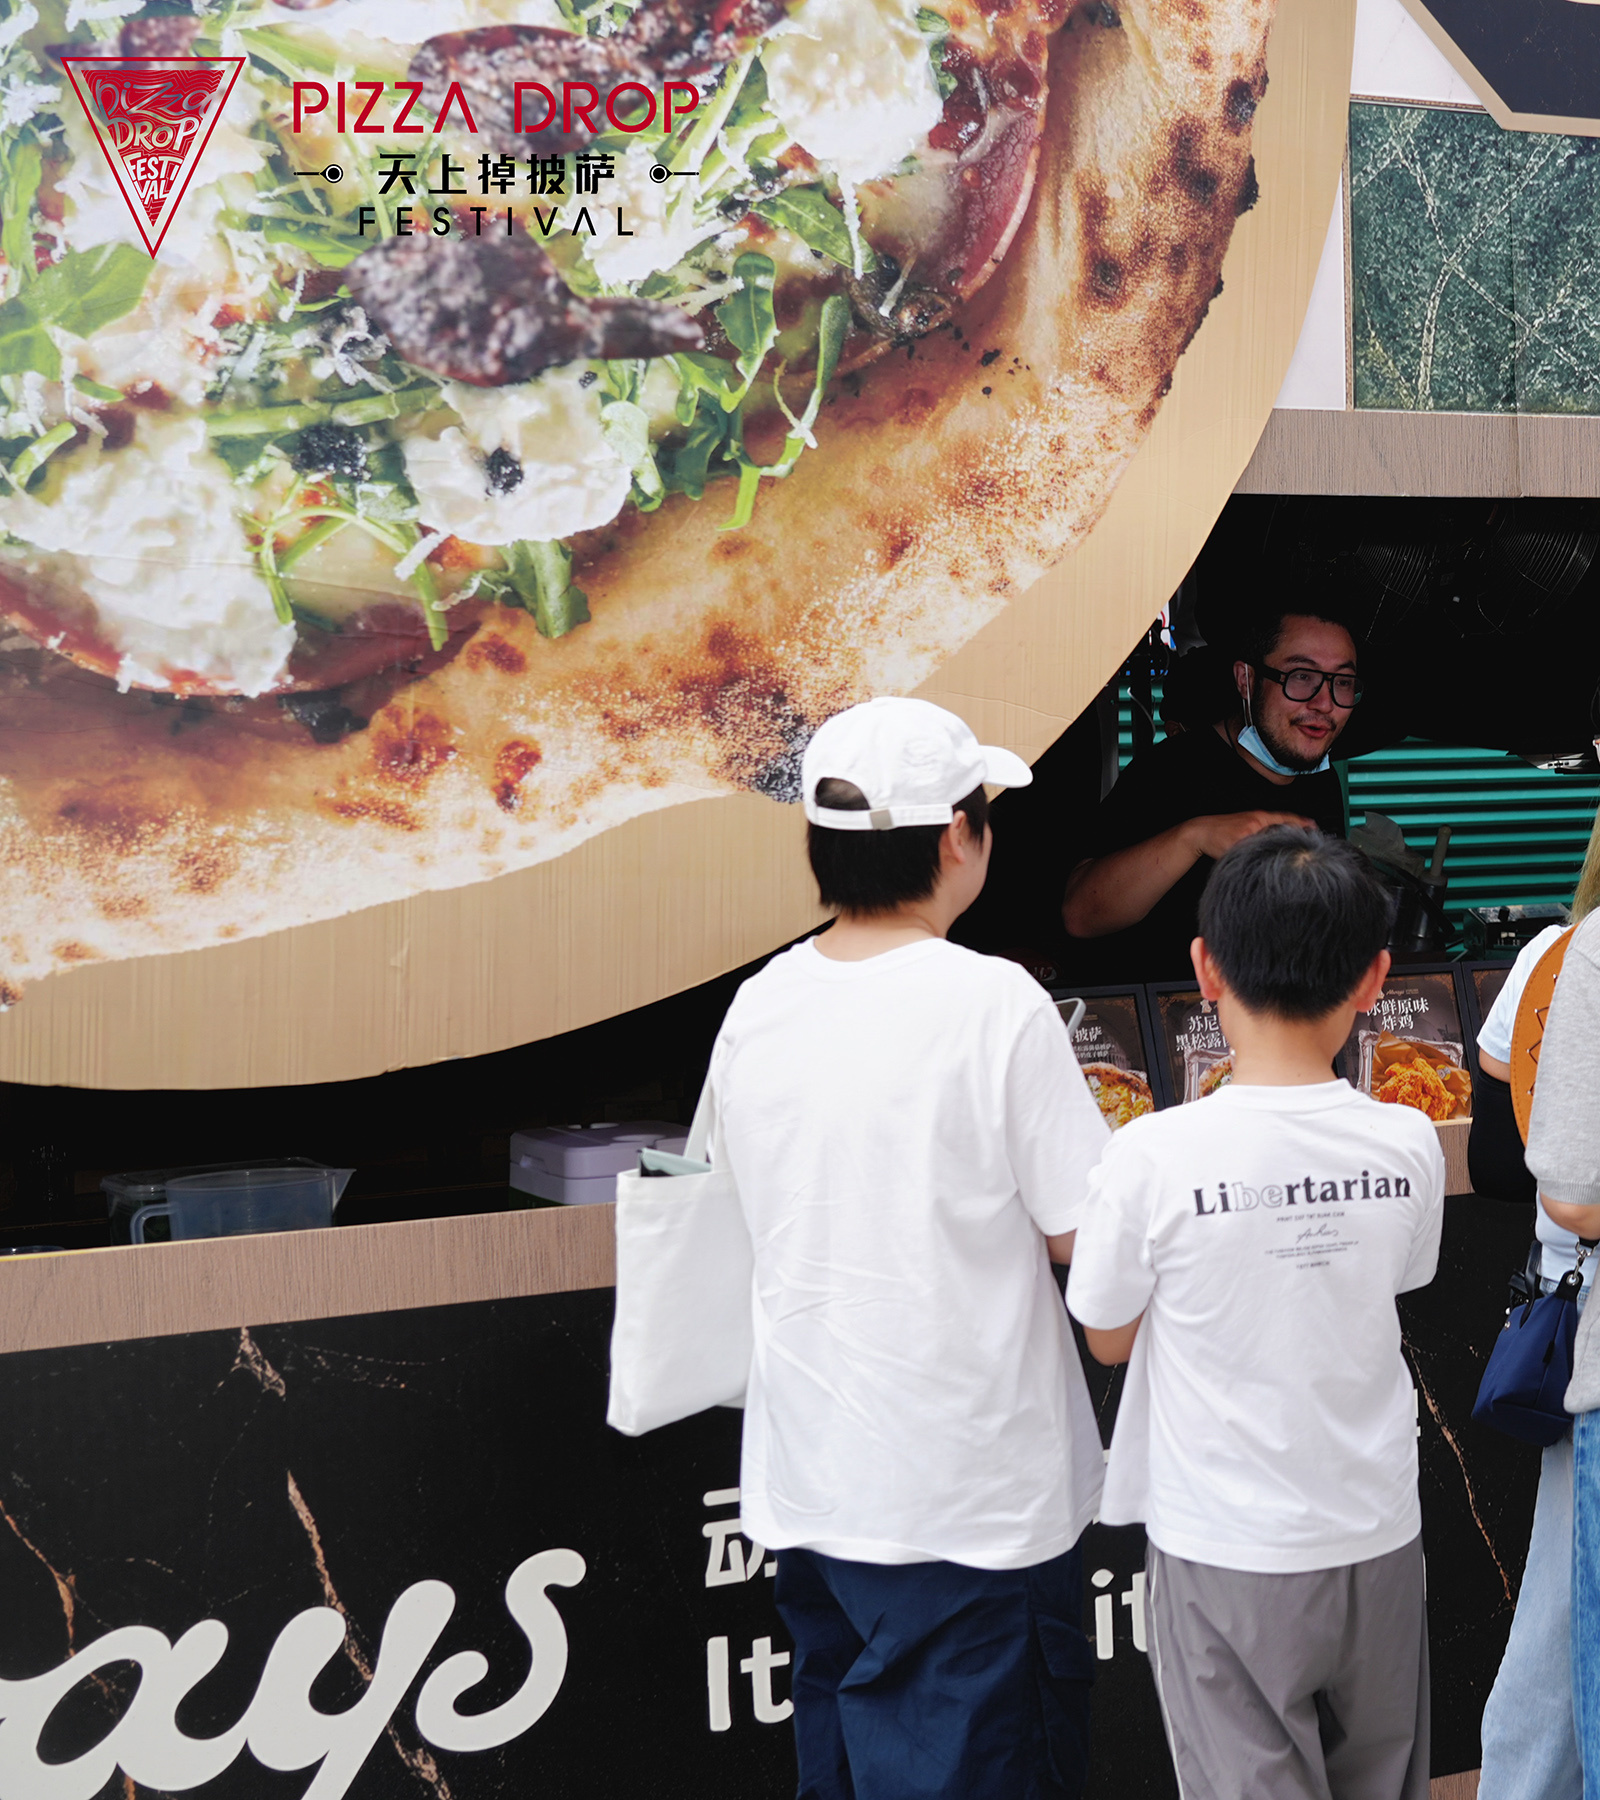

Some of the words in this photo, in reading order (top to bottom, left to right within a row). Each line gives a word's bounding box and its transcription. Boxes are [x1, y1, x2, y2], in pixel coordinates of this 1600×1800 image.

[1382, 1014, 1414, 1031] 炸鸡
[1072, 1026, 1103, 1043] 披萨
[1176, 1031, 1227, 1052] 黑松露
[1193, 1169, 1411, 1217] Libertarian
